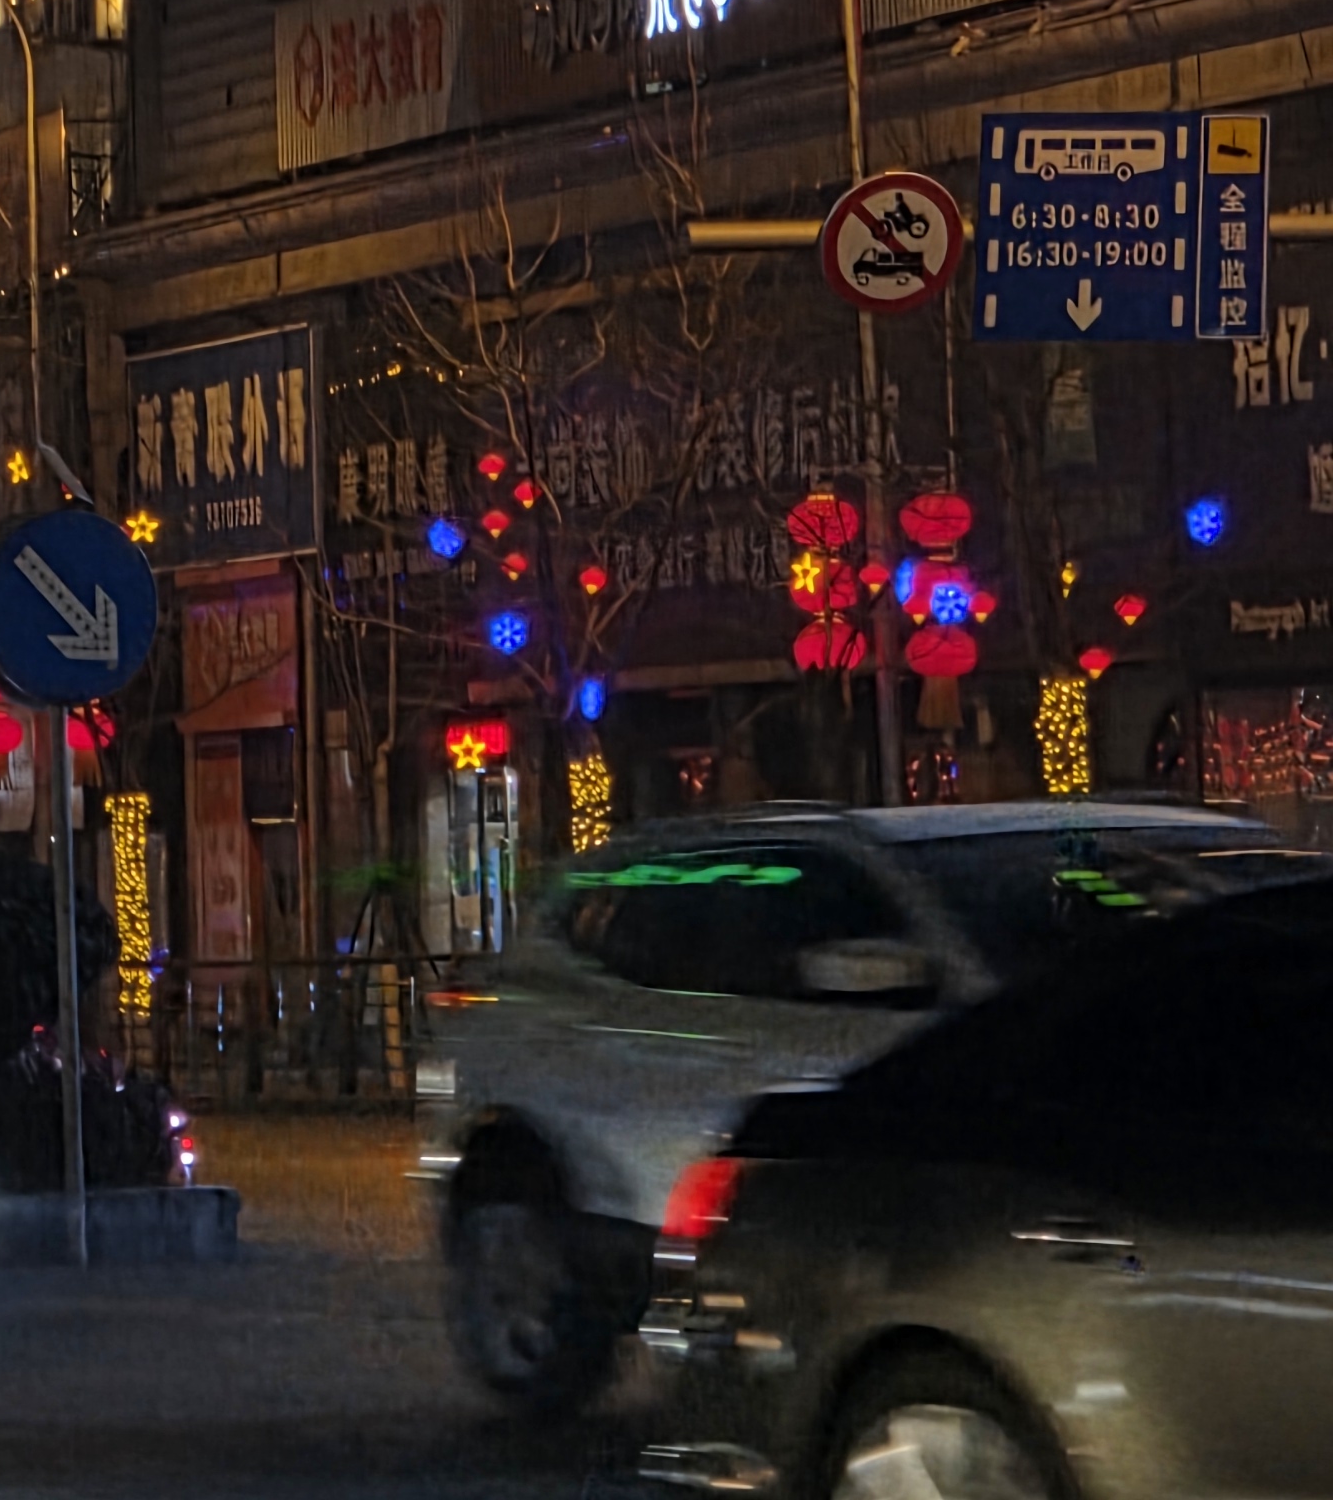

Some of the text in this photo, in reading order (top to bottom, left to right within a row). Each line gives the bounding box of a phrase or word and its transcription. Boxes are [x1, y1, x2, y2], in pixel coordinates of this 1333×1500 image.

[1006, 240, 1167, 268] 16:30-19:00
[1218, 183, 1249, 328] 全程监控
